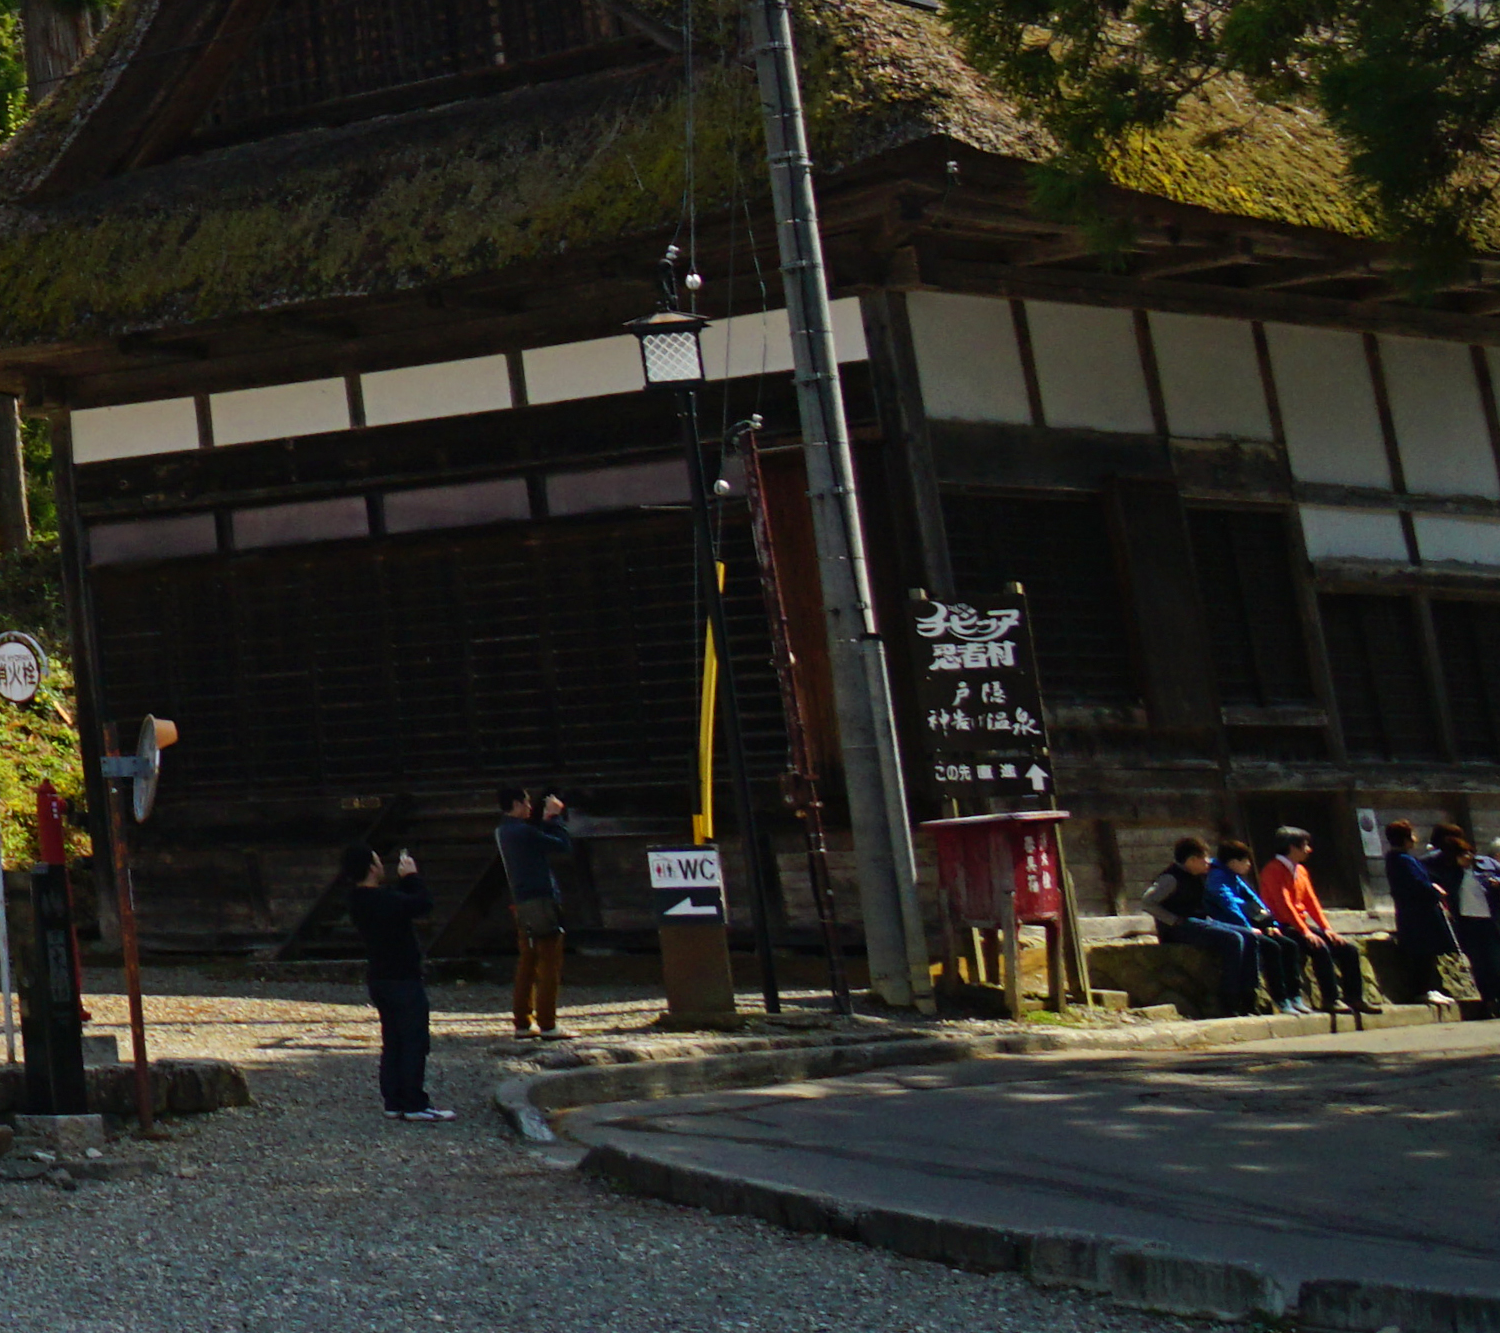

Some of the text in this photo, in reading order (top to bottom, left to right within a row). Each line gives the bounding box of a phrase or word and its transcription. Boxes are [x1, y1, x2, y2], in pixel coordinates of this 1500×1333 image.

[928, 640, 1016, 671] 忍者村
[677, 859, 715, 880] WC
